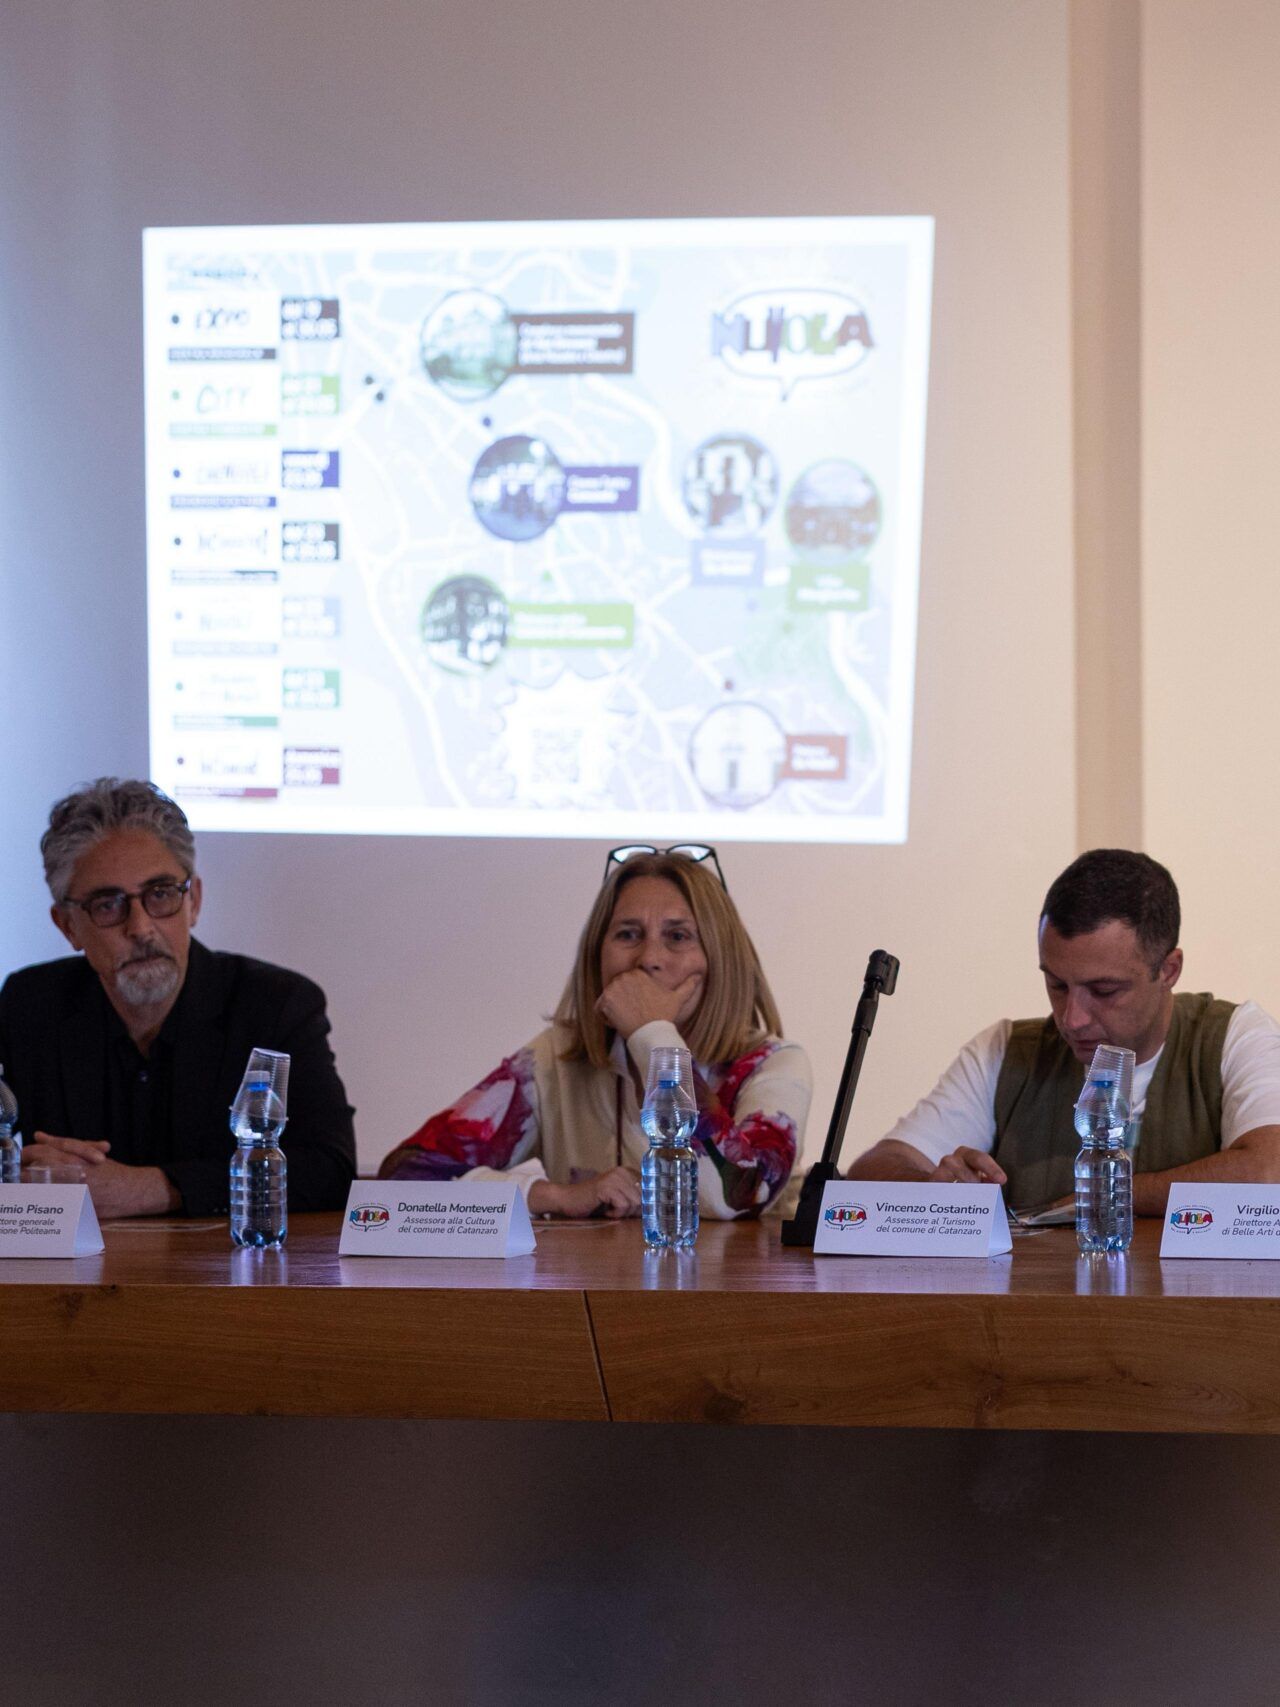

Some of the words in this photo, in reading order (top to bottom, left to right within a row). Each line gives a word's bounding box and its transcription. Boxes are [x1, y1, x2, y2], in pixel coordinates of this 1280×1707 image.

[0, 1204, 23, 1214] imio
[26, 1204, 64, 1214] Pisano
[398, 1202, 447, 1213] Donatella
[449, 1203, 507, 1214] Monteverdi
[876, 1202, 926, 1213] Vincenzo
[929, 1204, 990, 1215] Costantino
[1237, 1205, 1279, 1217] Virgilio
[18, 1218, 55, 1227] generale
[403, 1216, 446, 1225] Assessora
[447, 1217, 463, 1225] alla
[465, 1217, 495, 1225] Cultura
[885, 1216, 929, 1225] Assessore
[931, 1217, 939, 1225] al
[942, 1217, 976, 1226] Turismo
[1233, 1218, 1272, 1227] Direttore
[20, 1226, 61, 1235] Politeama
[447, 1226, 455, 1234] di
[457, 1226, 498, 1235] Catanzaro
[876, 1225, 890, 1233] del
[928, 1226, 936, 1234] di
[938, 1227, 982, 1235] Catanzaro
[1222, 1228, 1229, 1236] di
[1230, 1228, 1254, 1236] Belle
[1256, 1228, 1274, 1236] Arti
